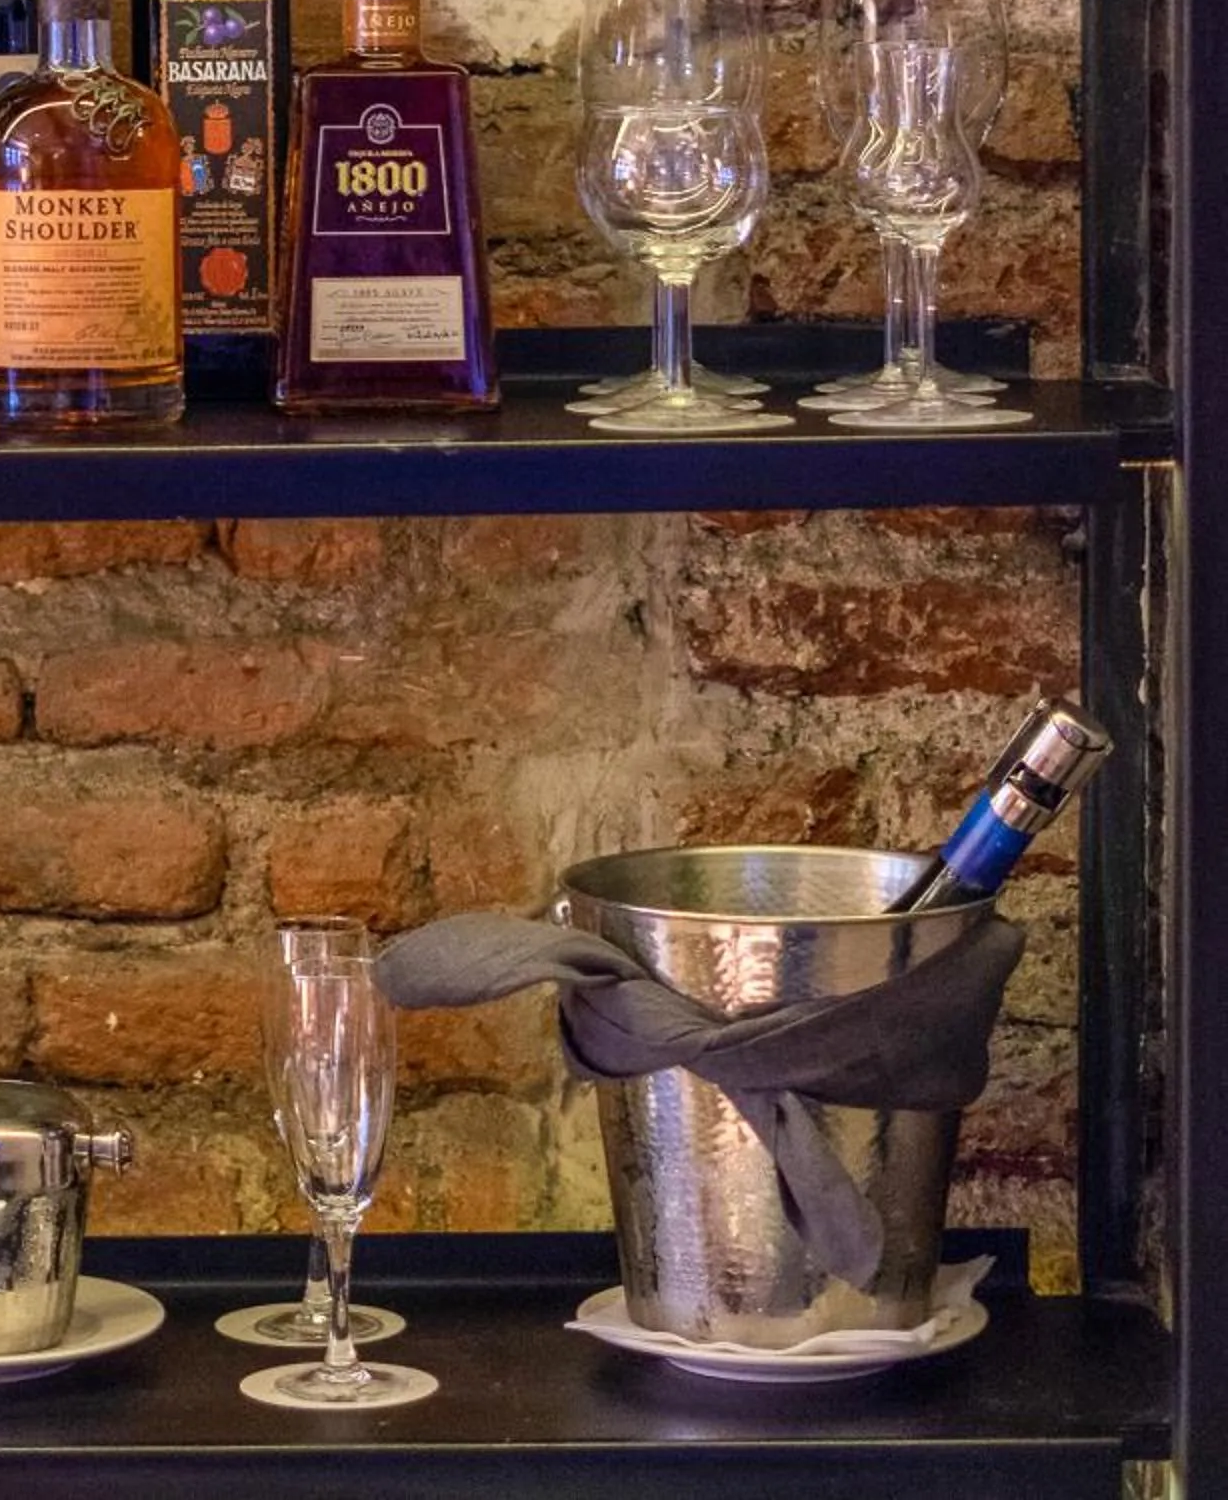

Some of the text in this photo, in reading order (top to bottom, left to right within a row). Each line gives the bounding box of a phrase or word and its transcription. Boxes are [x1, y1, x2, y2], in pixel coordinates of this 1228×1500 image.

[357, 13, 416, 30] AÑEJO
[168, 60, 267, 83] BASARANA
[335, 161, 427, 197] 1800
[15, 195, 127, 216] MONKEY
[347, 199, 414, 213] AÑEJO
[5, 219, 137, 241] SHOULDER
